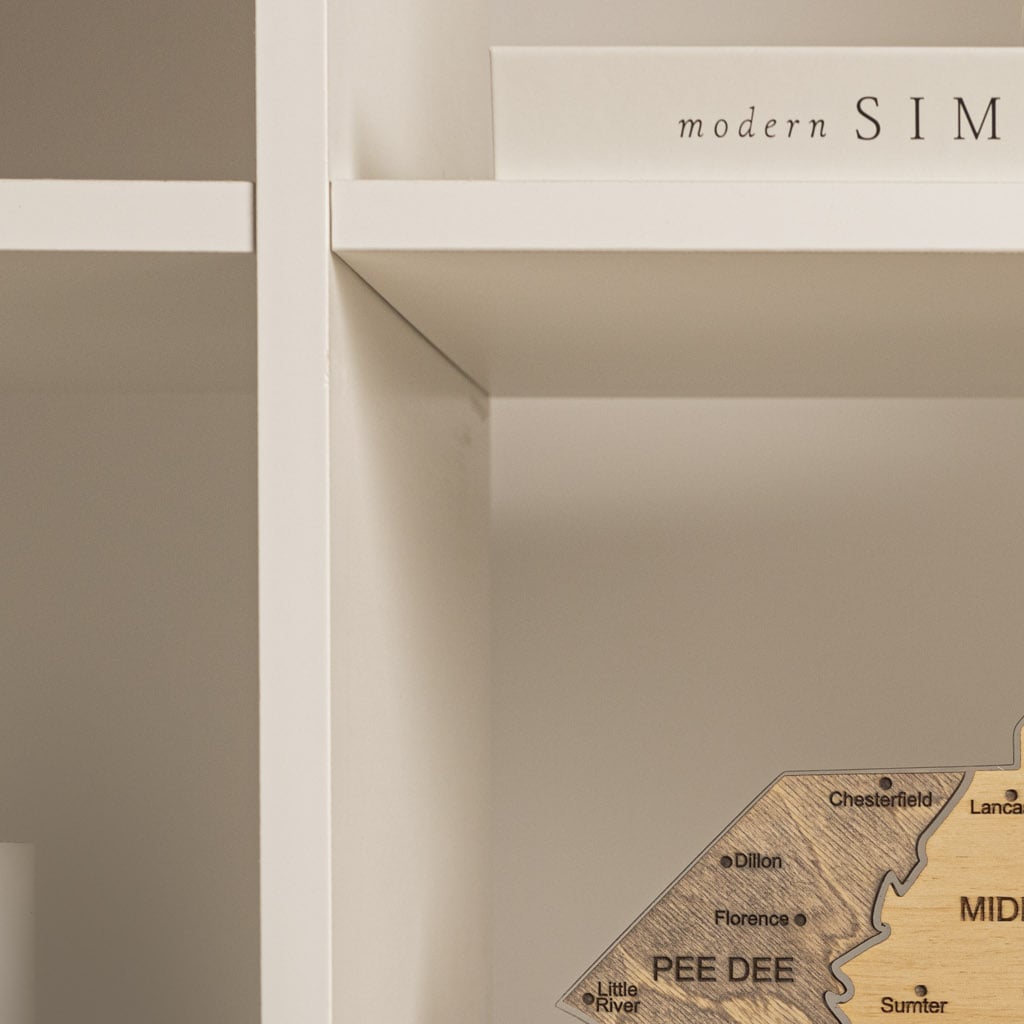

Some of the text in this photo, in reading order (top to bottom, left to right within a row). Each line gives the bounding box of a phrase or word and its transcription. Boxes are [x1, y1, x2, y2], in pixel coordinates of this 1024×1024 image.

[677, 105, 828, 140] modern
[829, 790, 933, 808] Chesterfield
[734, 853, 782, 869] Dillon
[714, 910, 789, 926] Florence
[652, 956, 795, 983] PEE DEE
[598, 982, 638, 997] Little
[596, 998, 640, 1013] River
[880, 998, 948, 1014] Sumter
